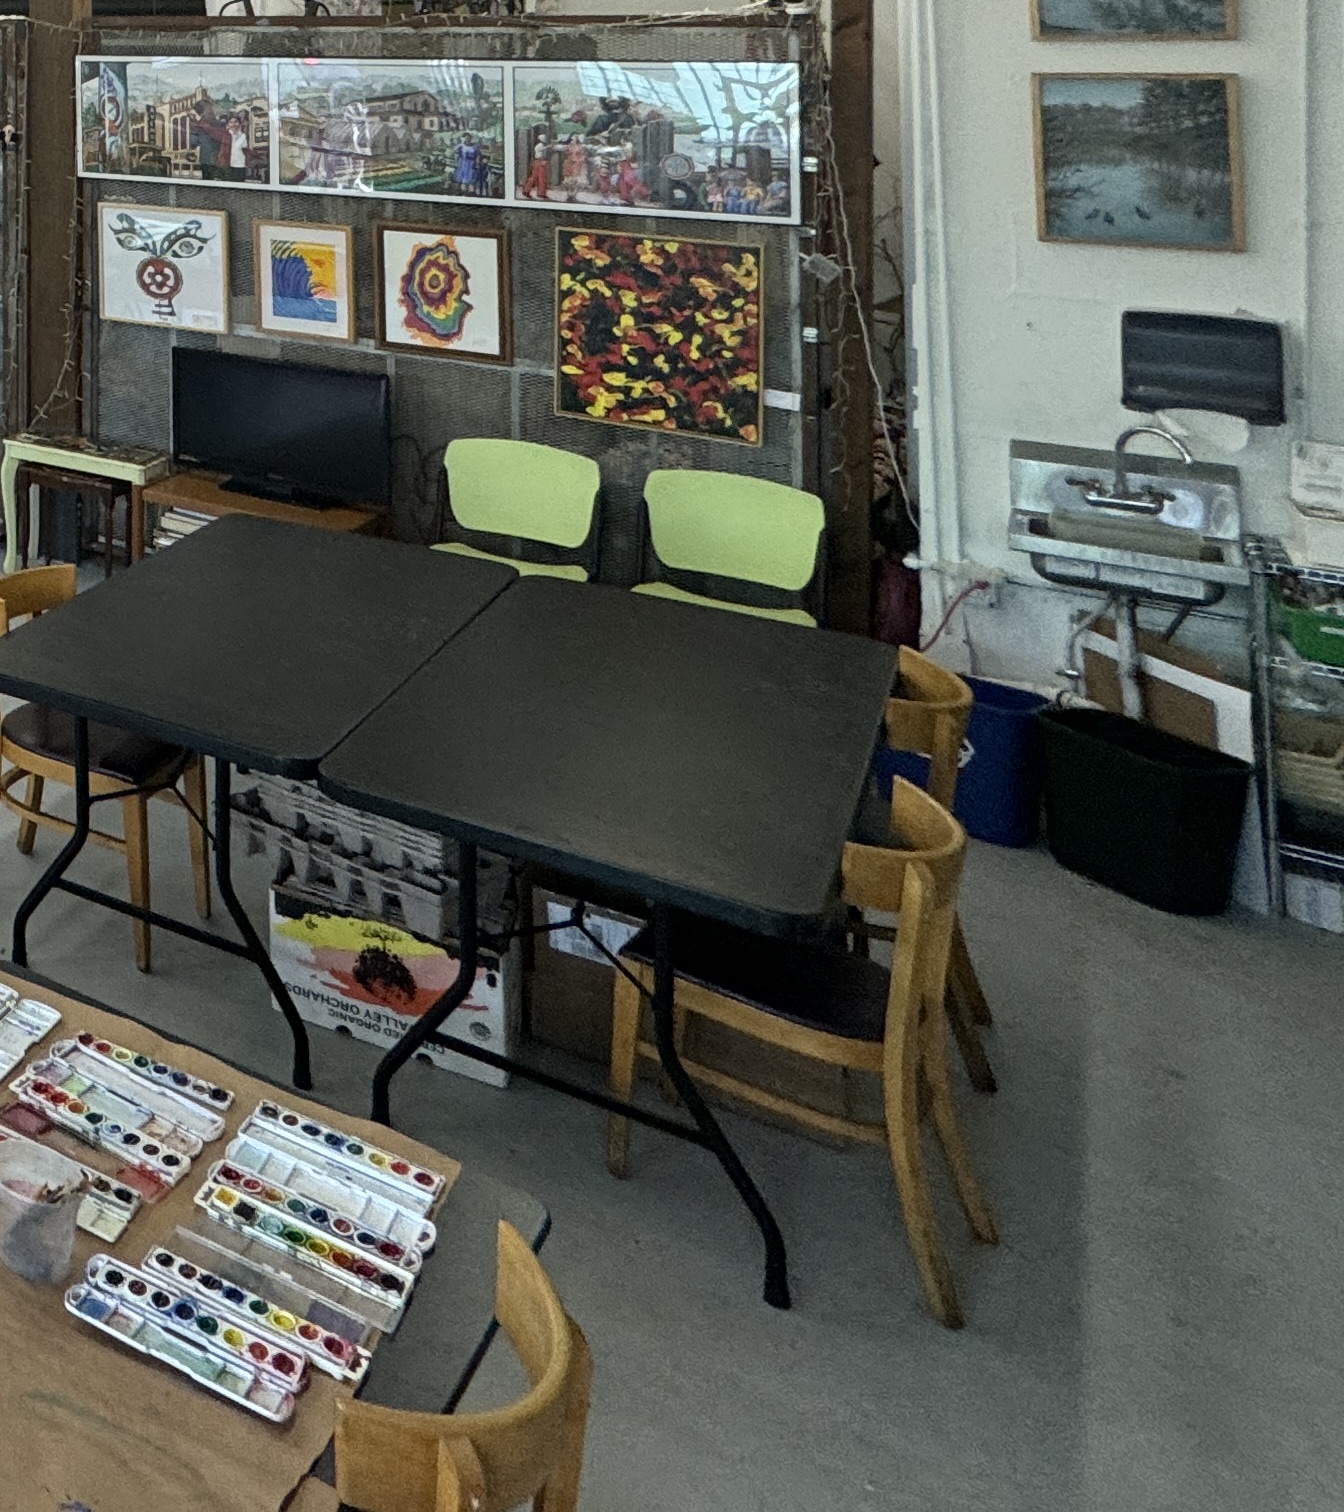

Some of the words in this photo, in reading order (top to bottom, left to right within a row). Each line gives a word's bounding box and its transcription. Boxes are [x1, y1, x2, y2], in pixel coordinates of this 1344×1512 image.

[284, 982, 360, 1016] ORCHARDS
[328, 1008, 382, 1033] ORGANIC
[364, 1008, 409, 1031] ALLEY
